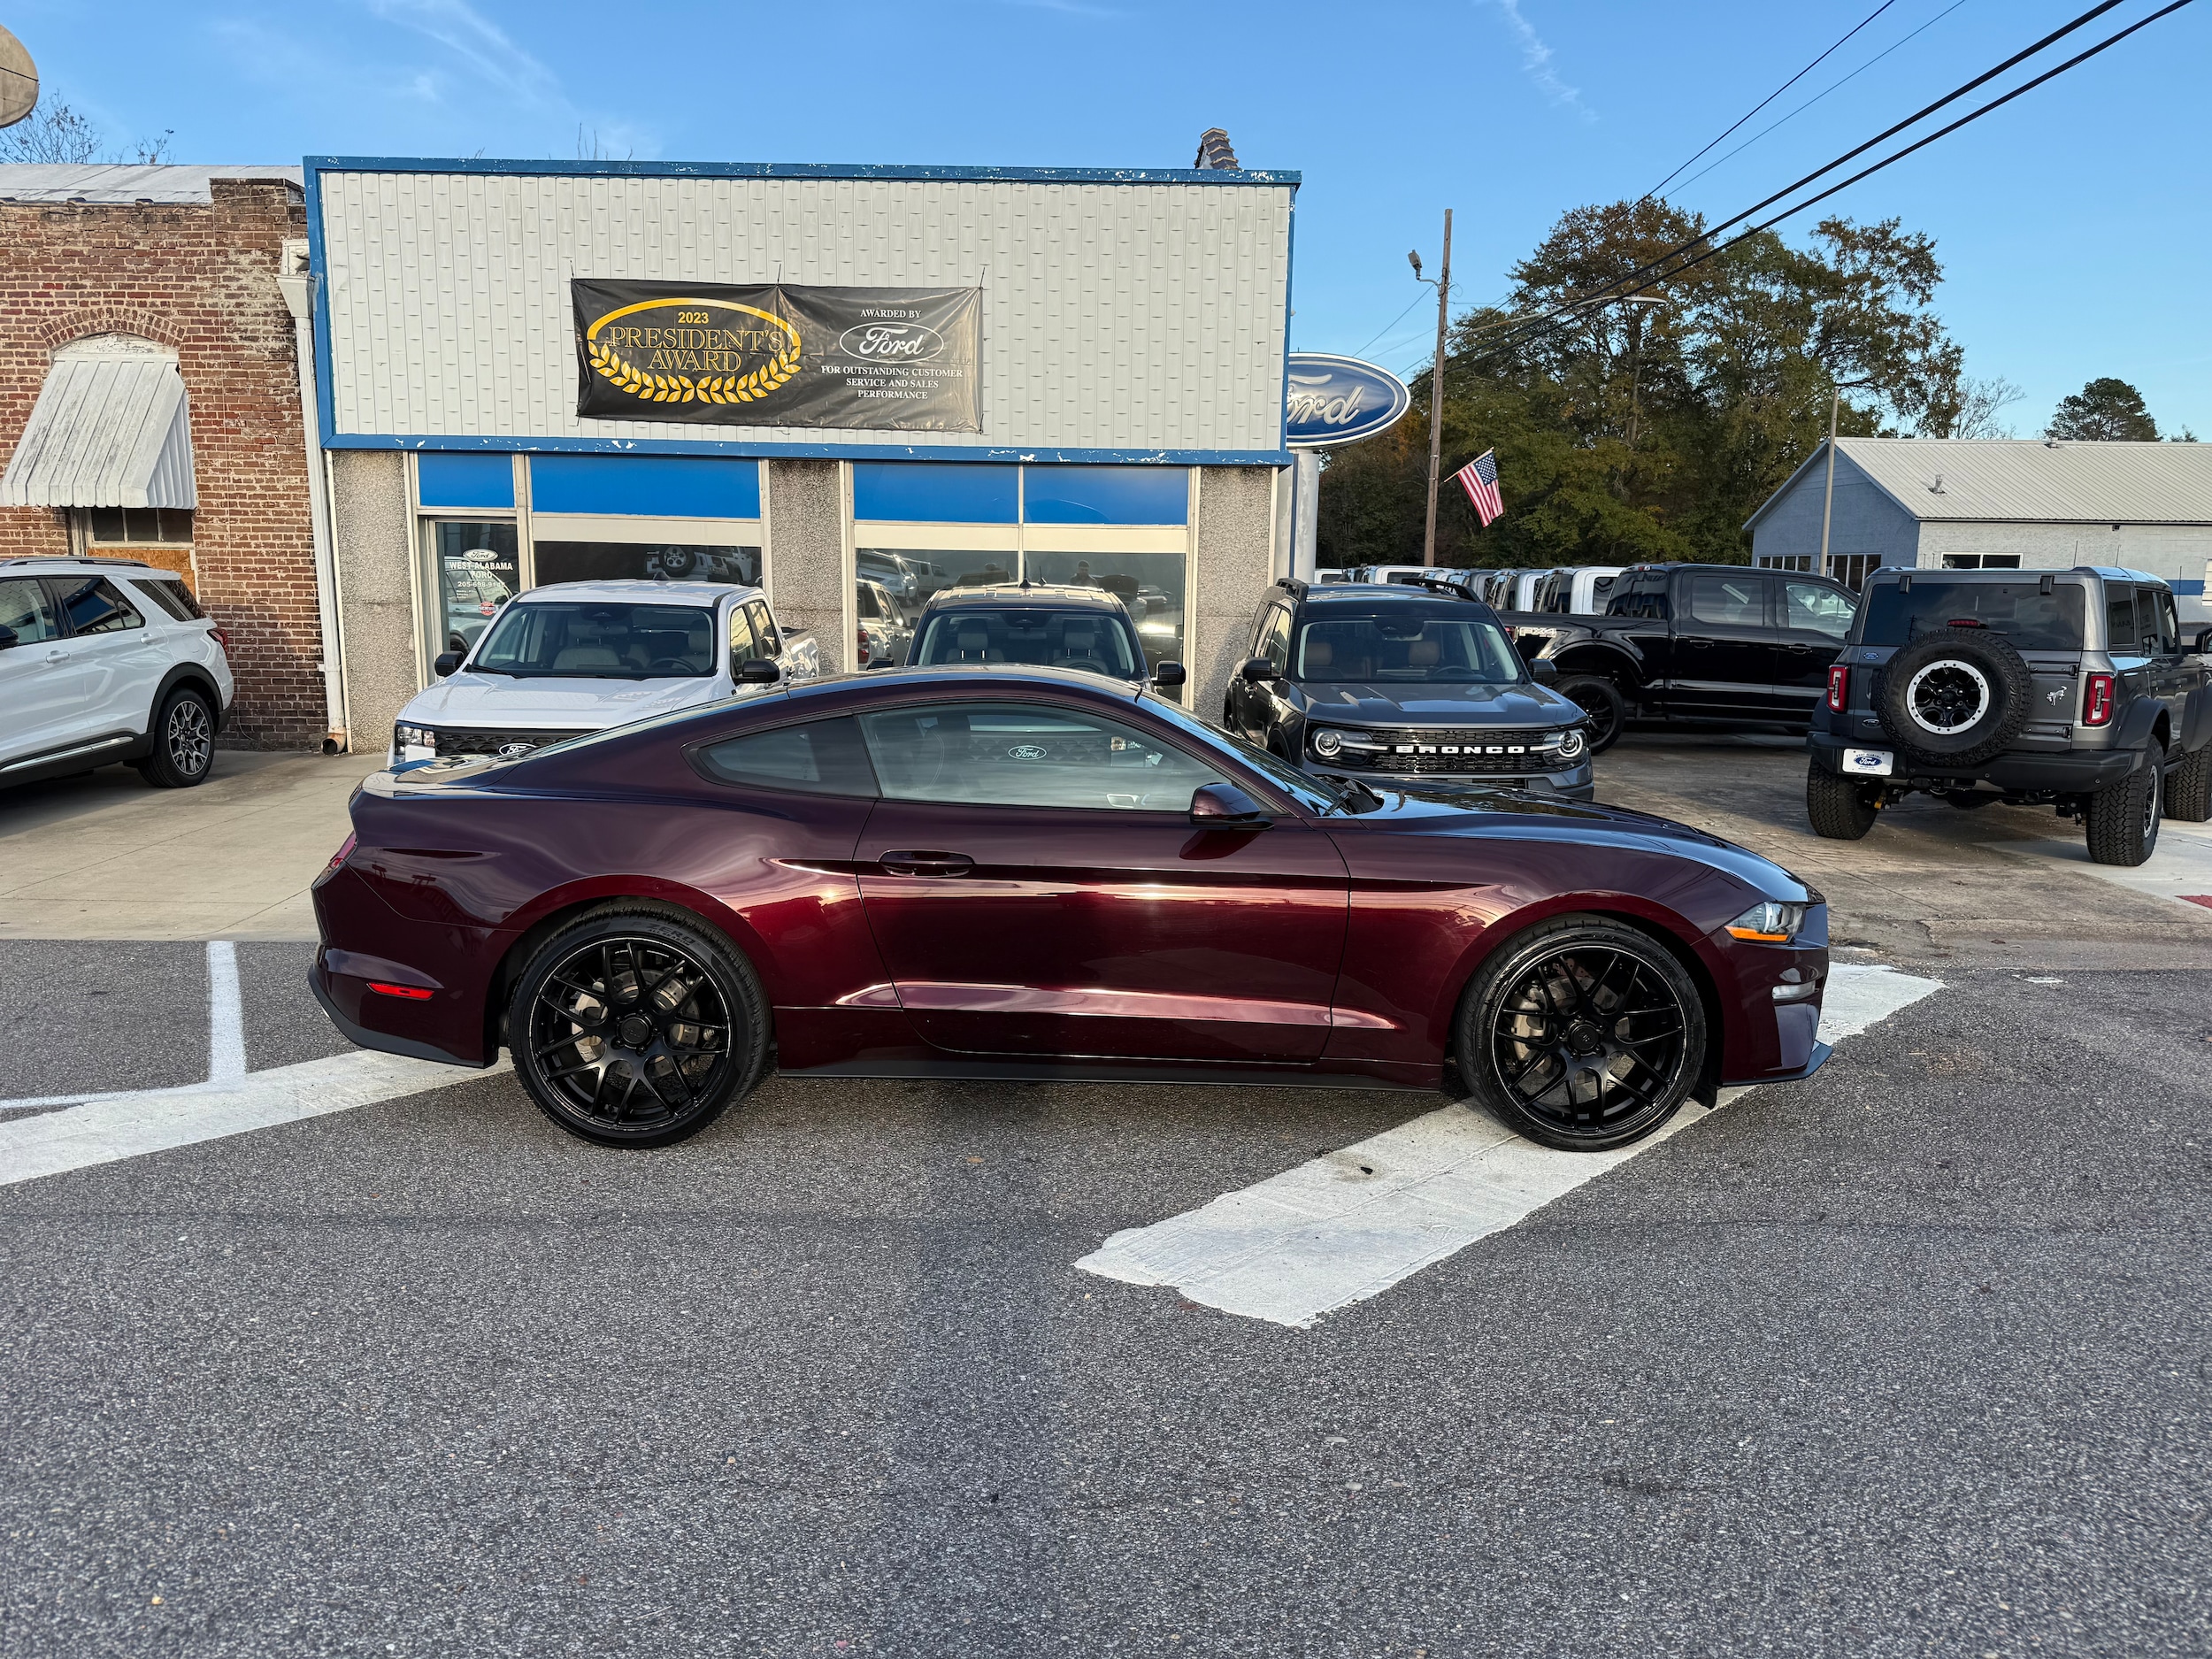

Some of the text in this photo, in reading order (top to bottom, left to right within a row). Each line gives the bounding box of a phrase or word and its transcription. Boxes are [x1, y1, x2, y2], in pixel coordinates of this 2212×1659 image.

[678, 311, 710, 324] 2023
[860, 309, 922, 319] AWARDED BY
[609, 326, 783, 352] PRESIDENT'S
[858, 326, 925, 355] Ford
[647, 349, 741, 373] AWARD
[821, 365, 964, 378] FOR OUTSTANDING CUSTOMER
[846, 378, 887, 388] SERVICE
[910, 380, 939, 388] SALES
[857, 389, 928, 399] PERFORMANCE
[1287, 373, 1364, 425] ord
[449, 561, 513, 571] WEST ALABAMA
[1016, 748, 1040, 757] Ford
[1395, 745, 1525, 754] BRONCO
[1859, 757, 1877, 765] Ford
[647, 923, 695, 944] ZERO
